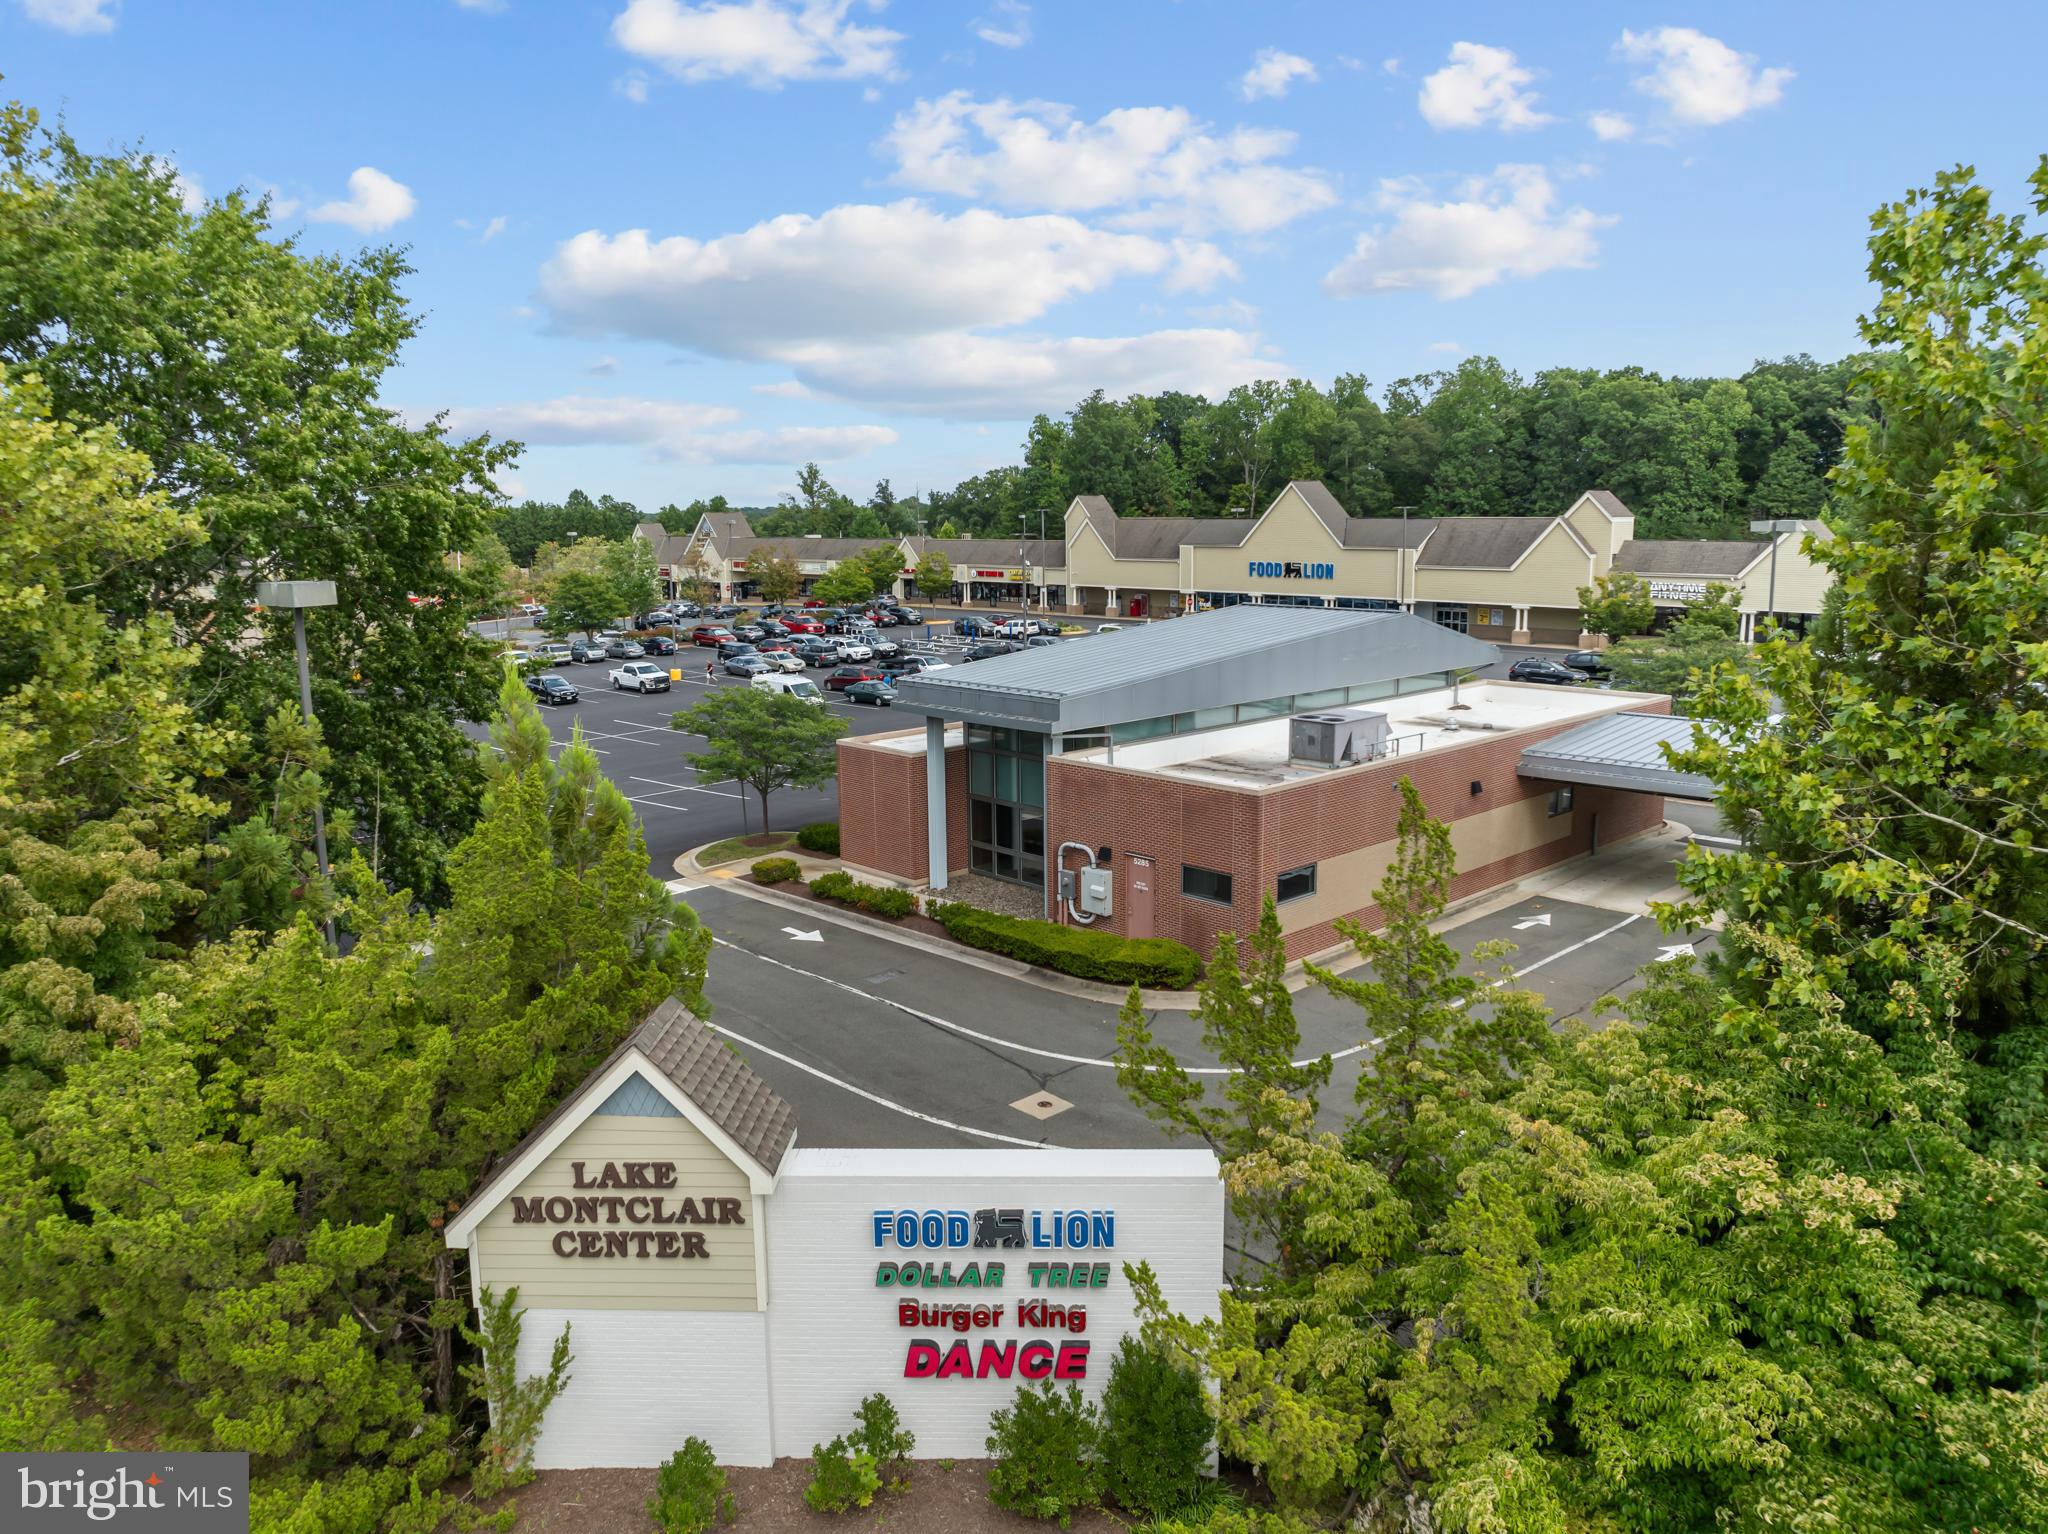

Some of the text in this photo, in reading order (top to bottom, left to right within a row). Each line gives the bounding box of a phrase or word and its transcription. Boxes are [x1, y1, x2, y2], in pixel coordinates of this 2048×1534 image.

[1248, 561, 1335, 580] FOOD LION
[1650, 581, 1707, 593] ANYTIME
[1650, 591, 1706, 601] FITNESS
[571, 1161, 678, 1188] LAKE
[511, 1196, 745, 1224] MONTCLAIR
[873, 1209, 1116, 1249] FOOD LION
[552, 1230, 710, 1258] CENTER
[876, 1262, 1111, 1288] DOLLAR TREE
[899, 1298, 1004, 1332] Burger
[904, 1339, 1090, 1379] DANCE
